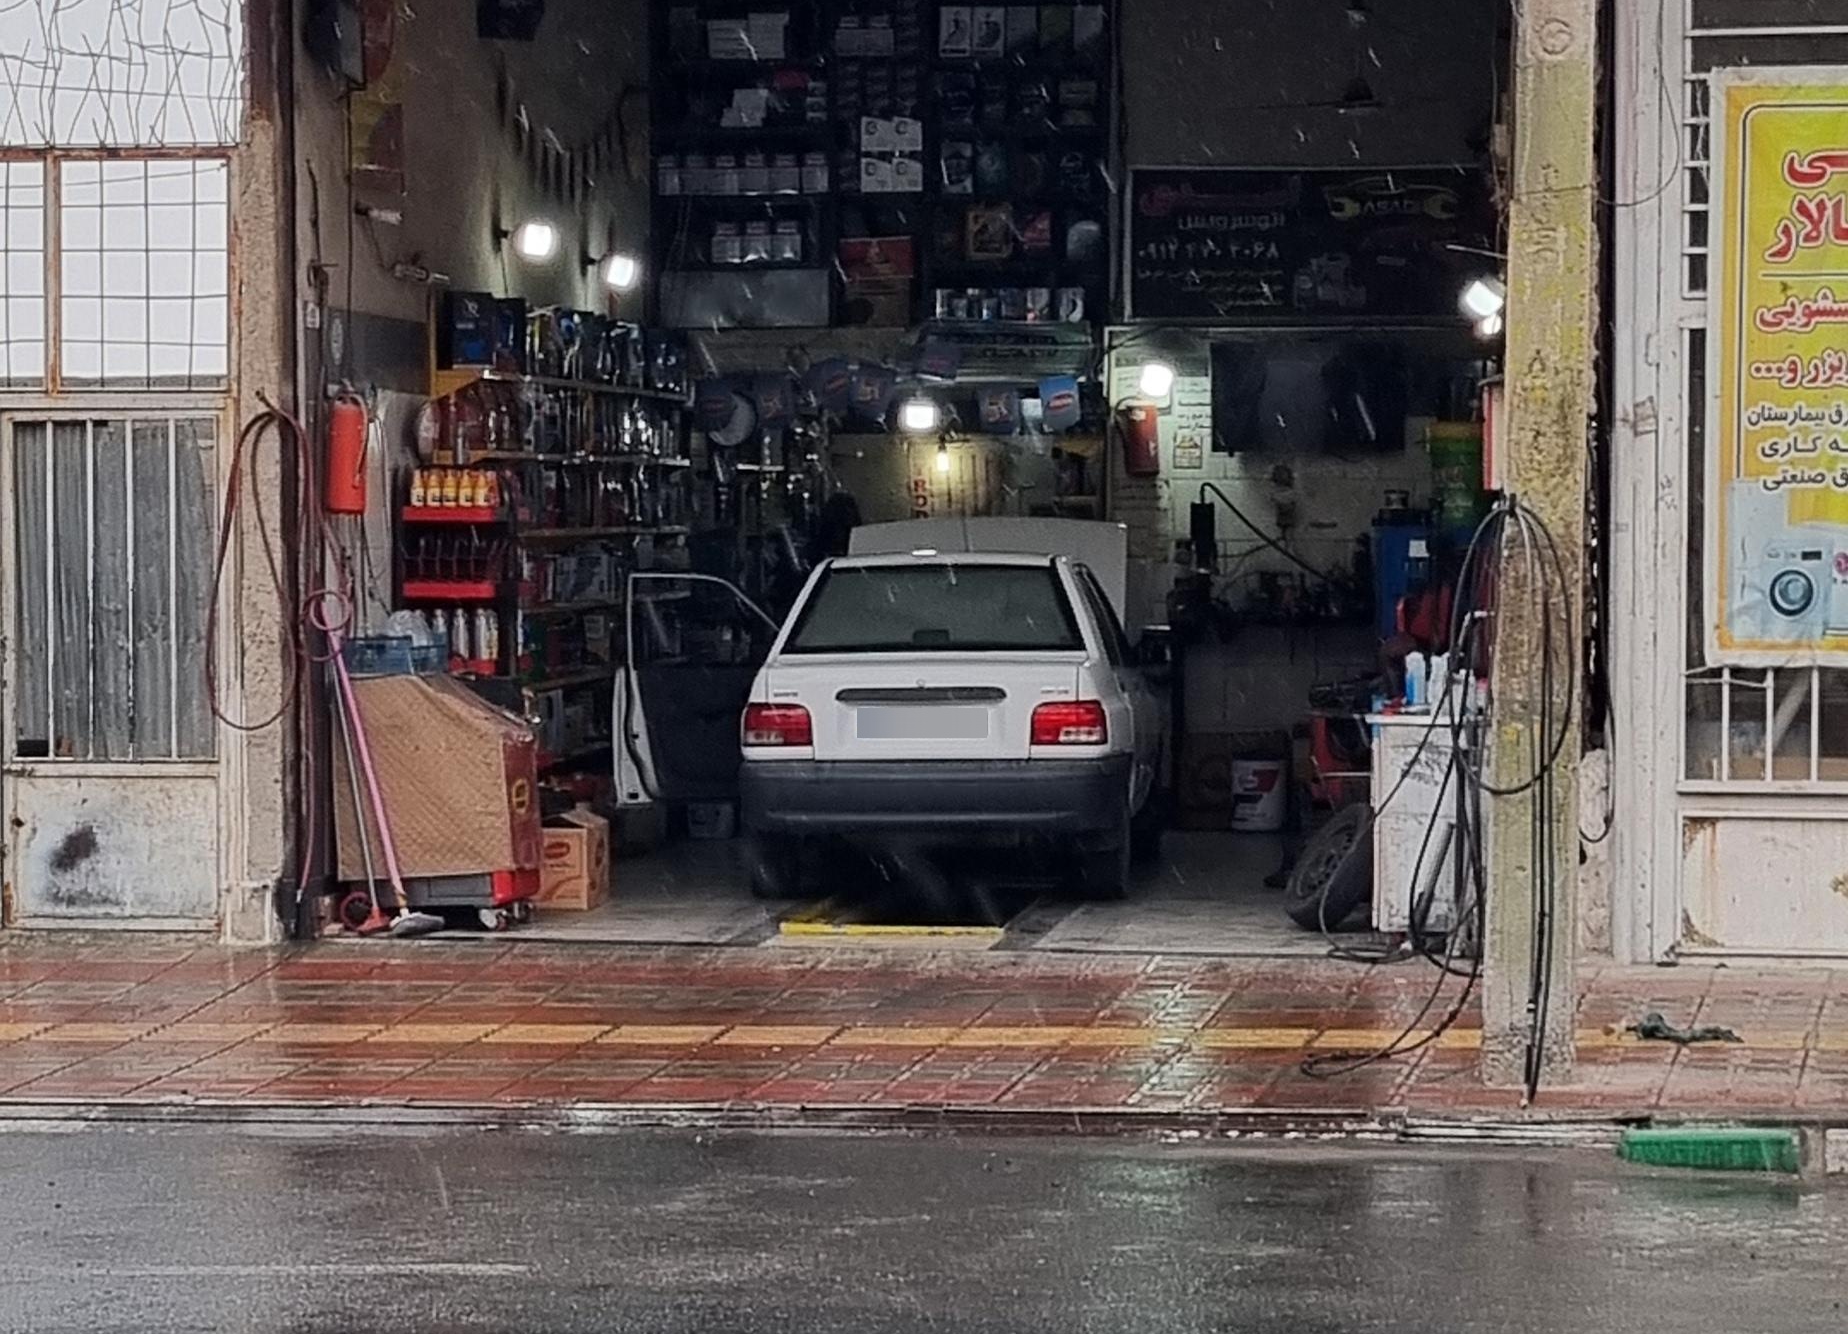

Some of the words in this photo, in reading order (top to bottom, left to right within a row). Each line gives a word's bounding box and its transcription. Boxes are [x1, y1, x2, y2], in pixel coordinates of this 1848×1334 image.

[1747, 404, 1826, 428] بیمارستان
[1760, 435, 1823, 458] کاری
[1762, 468, 1827, 492] صنعتی
